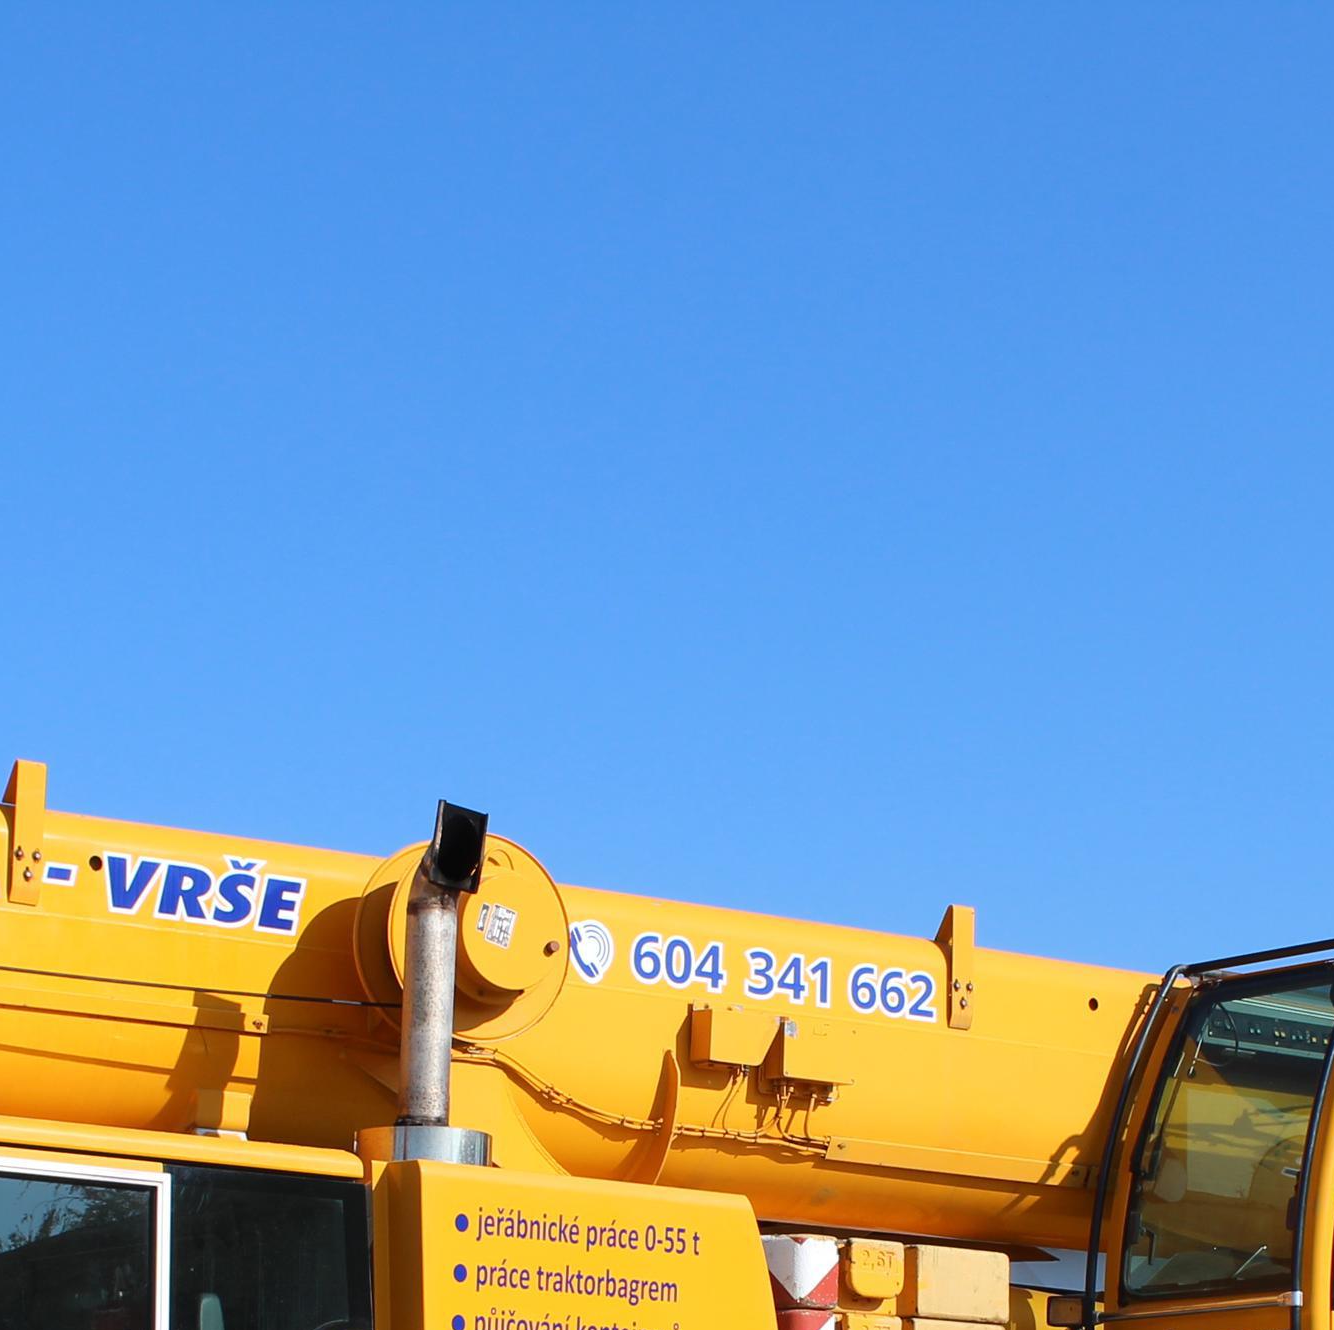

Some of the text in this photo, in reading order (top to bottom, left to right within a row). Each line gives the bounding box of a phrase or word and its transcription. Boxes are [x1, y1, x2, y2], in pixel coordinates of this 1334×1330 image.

[105, 855, 303, 932] VRŠE
[633, 935, 935, 1018] 604 341 662
[476, 1207, 700, 1256] jeřábnické práce 0-55 t
[476, 1259, 678, 1306] práce traktorbagrem
